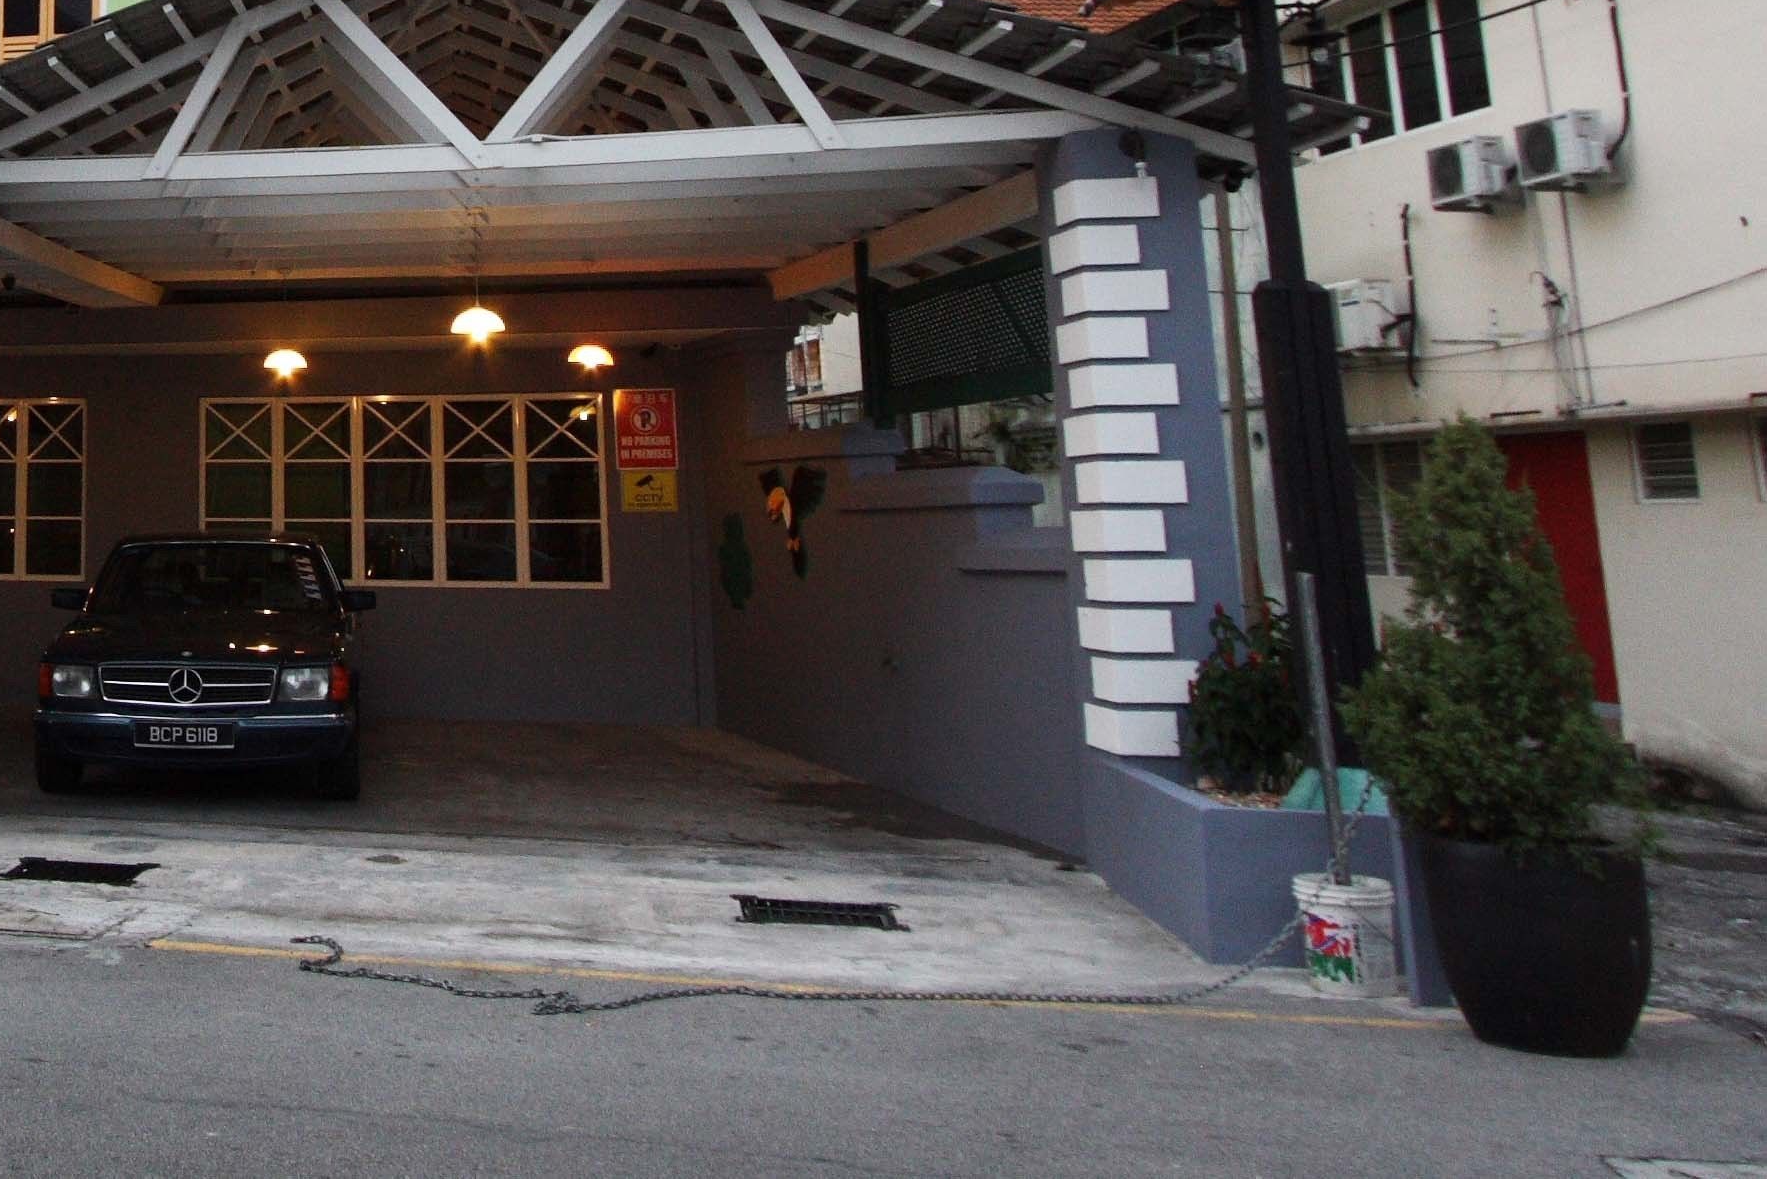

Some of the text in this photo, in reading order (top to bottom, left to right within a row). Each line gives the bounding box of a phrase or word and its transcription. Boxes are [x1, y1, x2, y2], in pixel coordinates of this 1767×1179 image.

[621, 436, 671, 446] NO PARKING
[632, 449, 673, 460] PREMISES
[636, 494, 663, 503] CCTV
